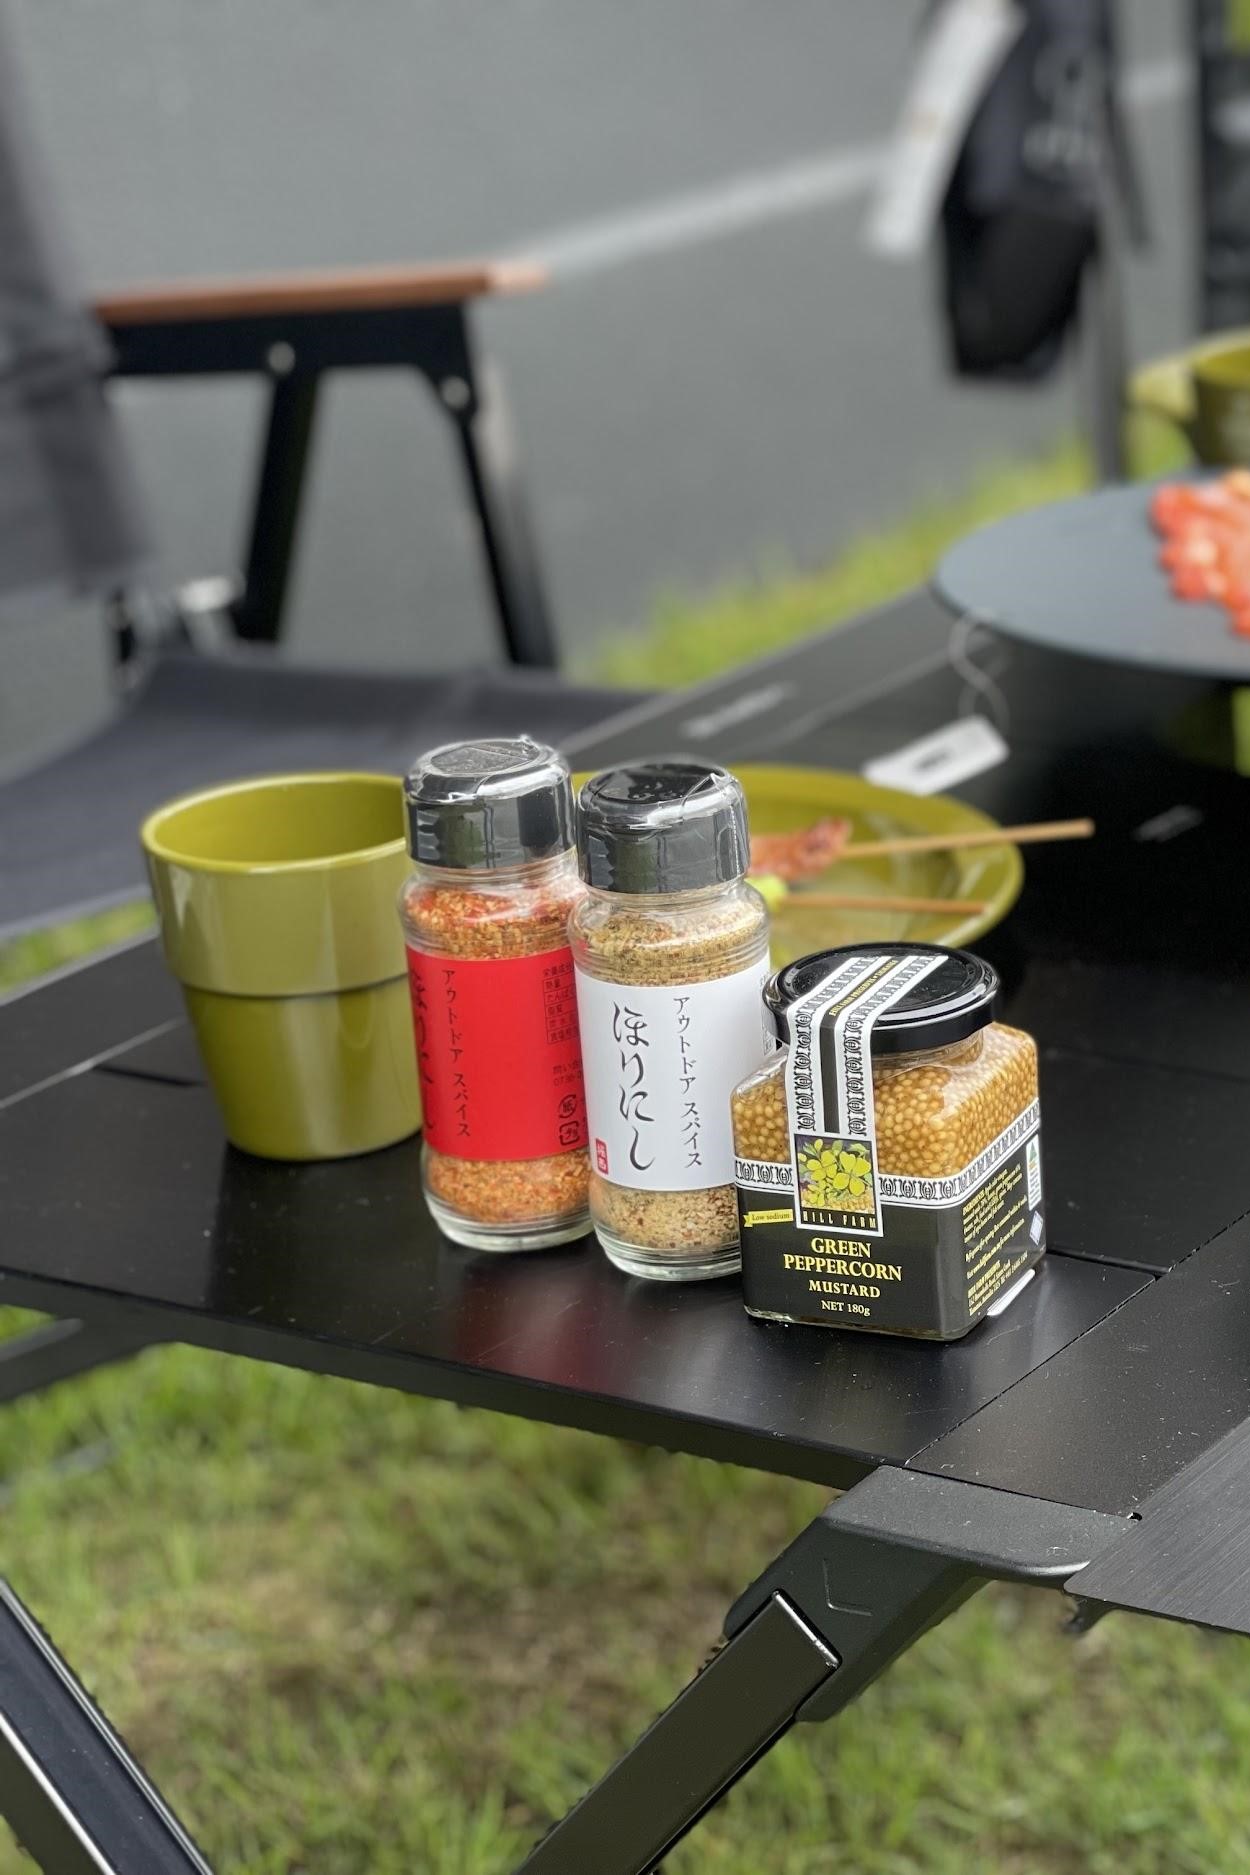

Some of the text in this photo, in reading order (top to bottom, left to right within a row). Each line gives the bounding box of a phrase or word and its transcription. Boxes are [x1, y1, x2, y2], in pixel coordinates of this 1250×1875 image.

[442, 969, 471, 1137] アウトドア スパイス
[613, 1001, 656, 1171] ほりにし
[673, 996, 703, 1169] アウトドア スパイス
[751, 1213, 765, 1221] Low
[803, 1210, 877, 1229] HILL FARM
[811, 1237, 871, 1258] GREEN
[783, 1253, 902, 1281] PEPPERCORN
[809, 1279, 881, 1298] MUSTARD
[821, 1300, 871, 1317] NET 180g
